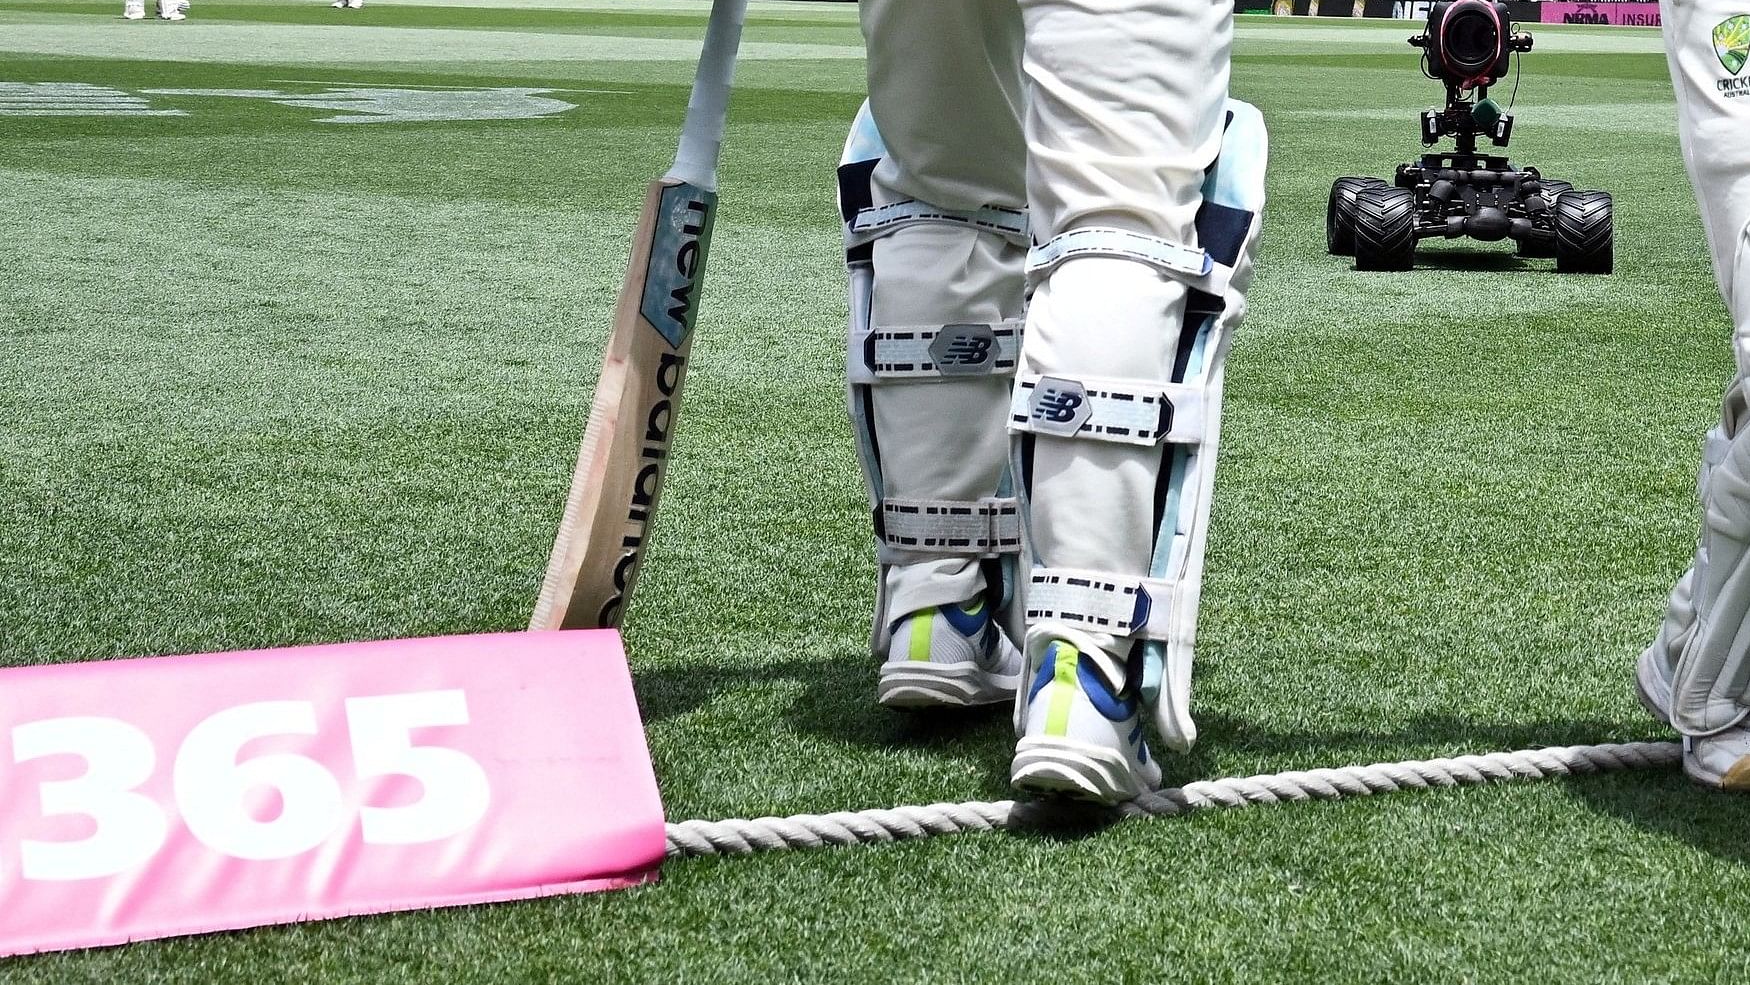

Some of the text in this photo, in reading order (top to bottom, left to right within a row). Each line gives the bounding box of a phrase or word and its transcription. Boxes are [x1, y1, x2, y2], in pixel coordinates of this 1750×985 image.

[1563, 12, 1610, 24] NRMA
[670, 200, 709, 333] new
[11, 688, 491, 881] 365
